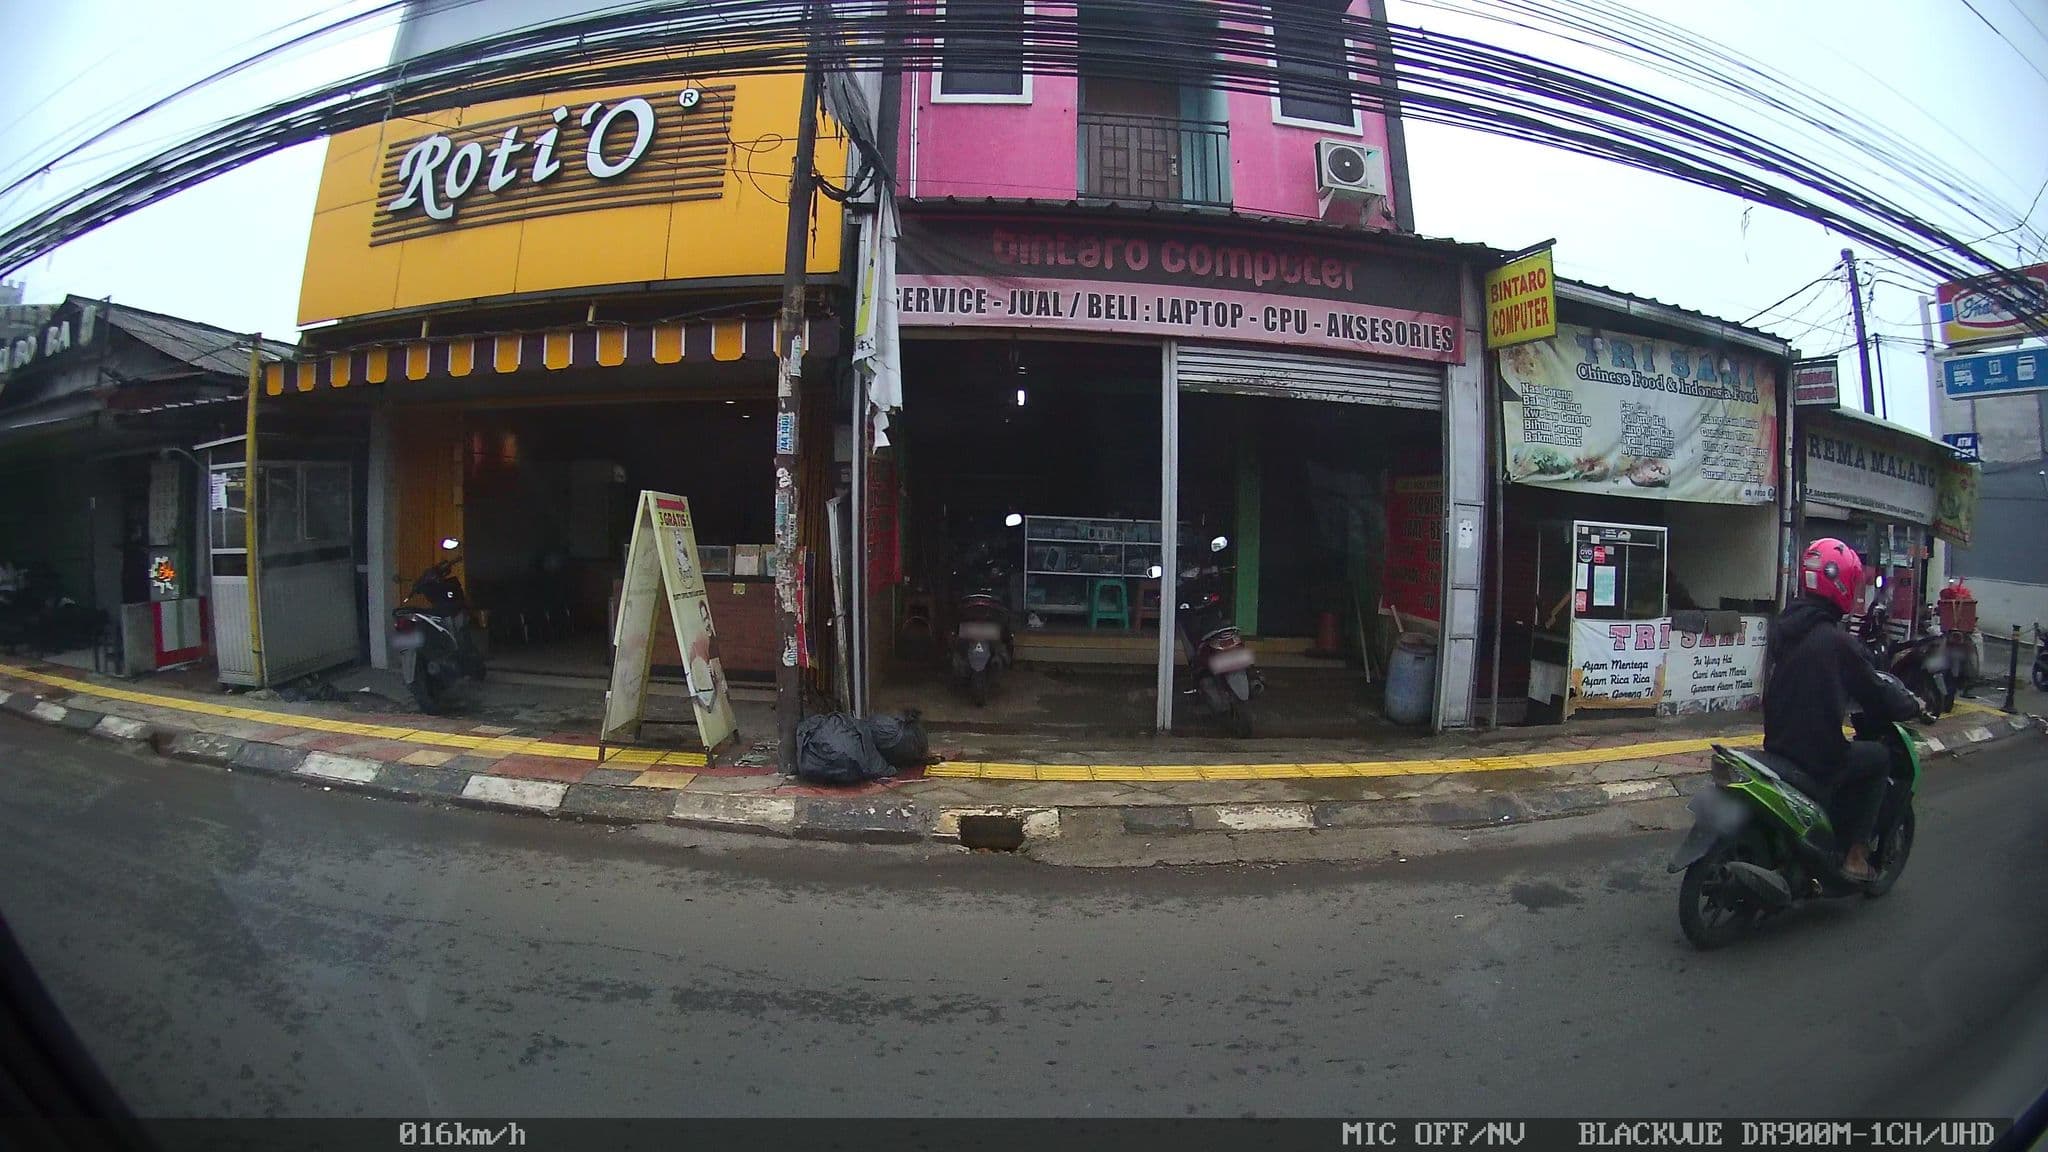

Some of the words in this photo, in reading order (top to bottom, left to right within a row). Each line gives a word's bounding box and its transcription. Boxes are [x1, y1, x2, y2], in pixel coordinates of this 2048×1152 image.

[387, 97, 655, 221] Roti'O
[1490, 268, 1547, 303] BINTARO
[1008, 290, 1062, 317] JUAL
[1087, 294, 1137, 321] BELI
[1156, 297, 1243, 328] LAPTOP
[1264, 306, 1308, 334] CPU
[1327, 313, 1454, 351] AKSESORIES
[1492, 297, 1549, 337] COMPUTER
[1577, 362, 1630, 385] Chinese
[1633, 370, 1665, 391] Food
[1609, 623, 1671, 651] TRI
[1581, 676, 1607, 688] Ayam
[1610, 674, 1629, 684] Rica
[1633, 673, 1650, 683] Rica
[1582, 660, 1607, 673] Ayam
[1611, 660, 1649, 671] Mentega
